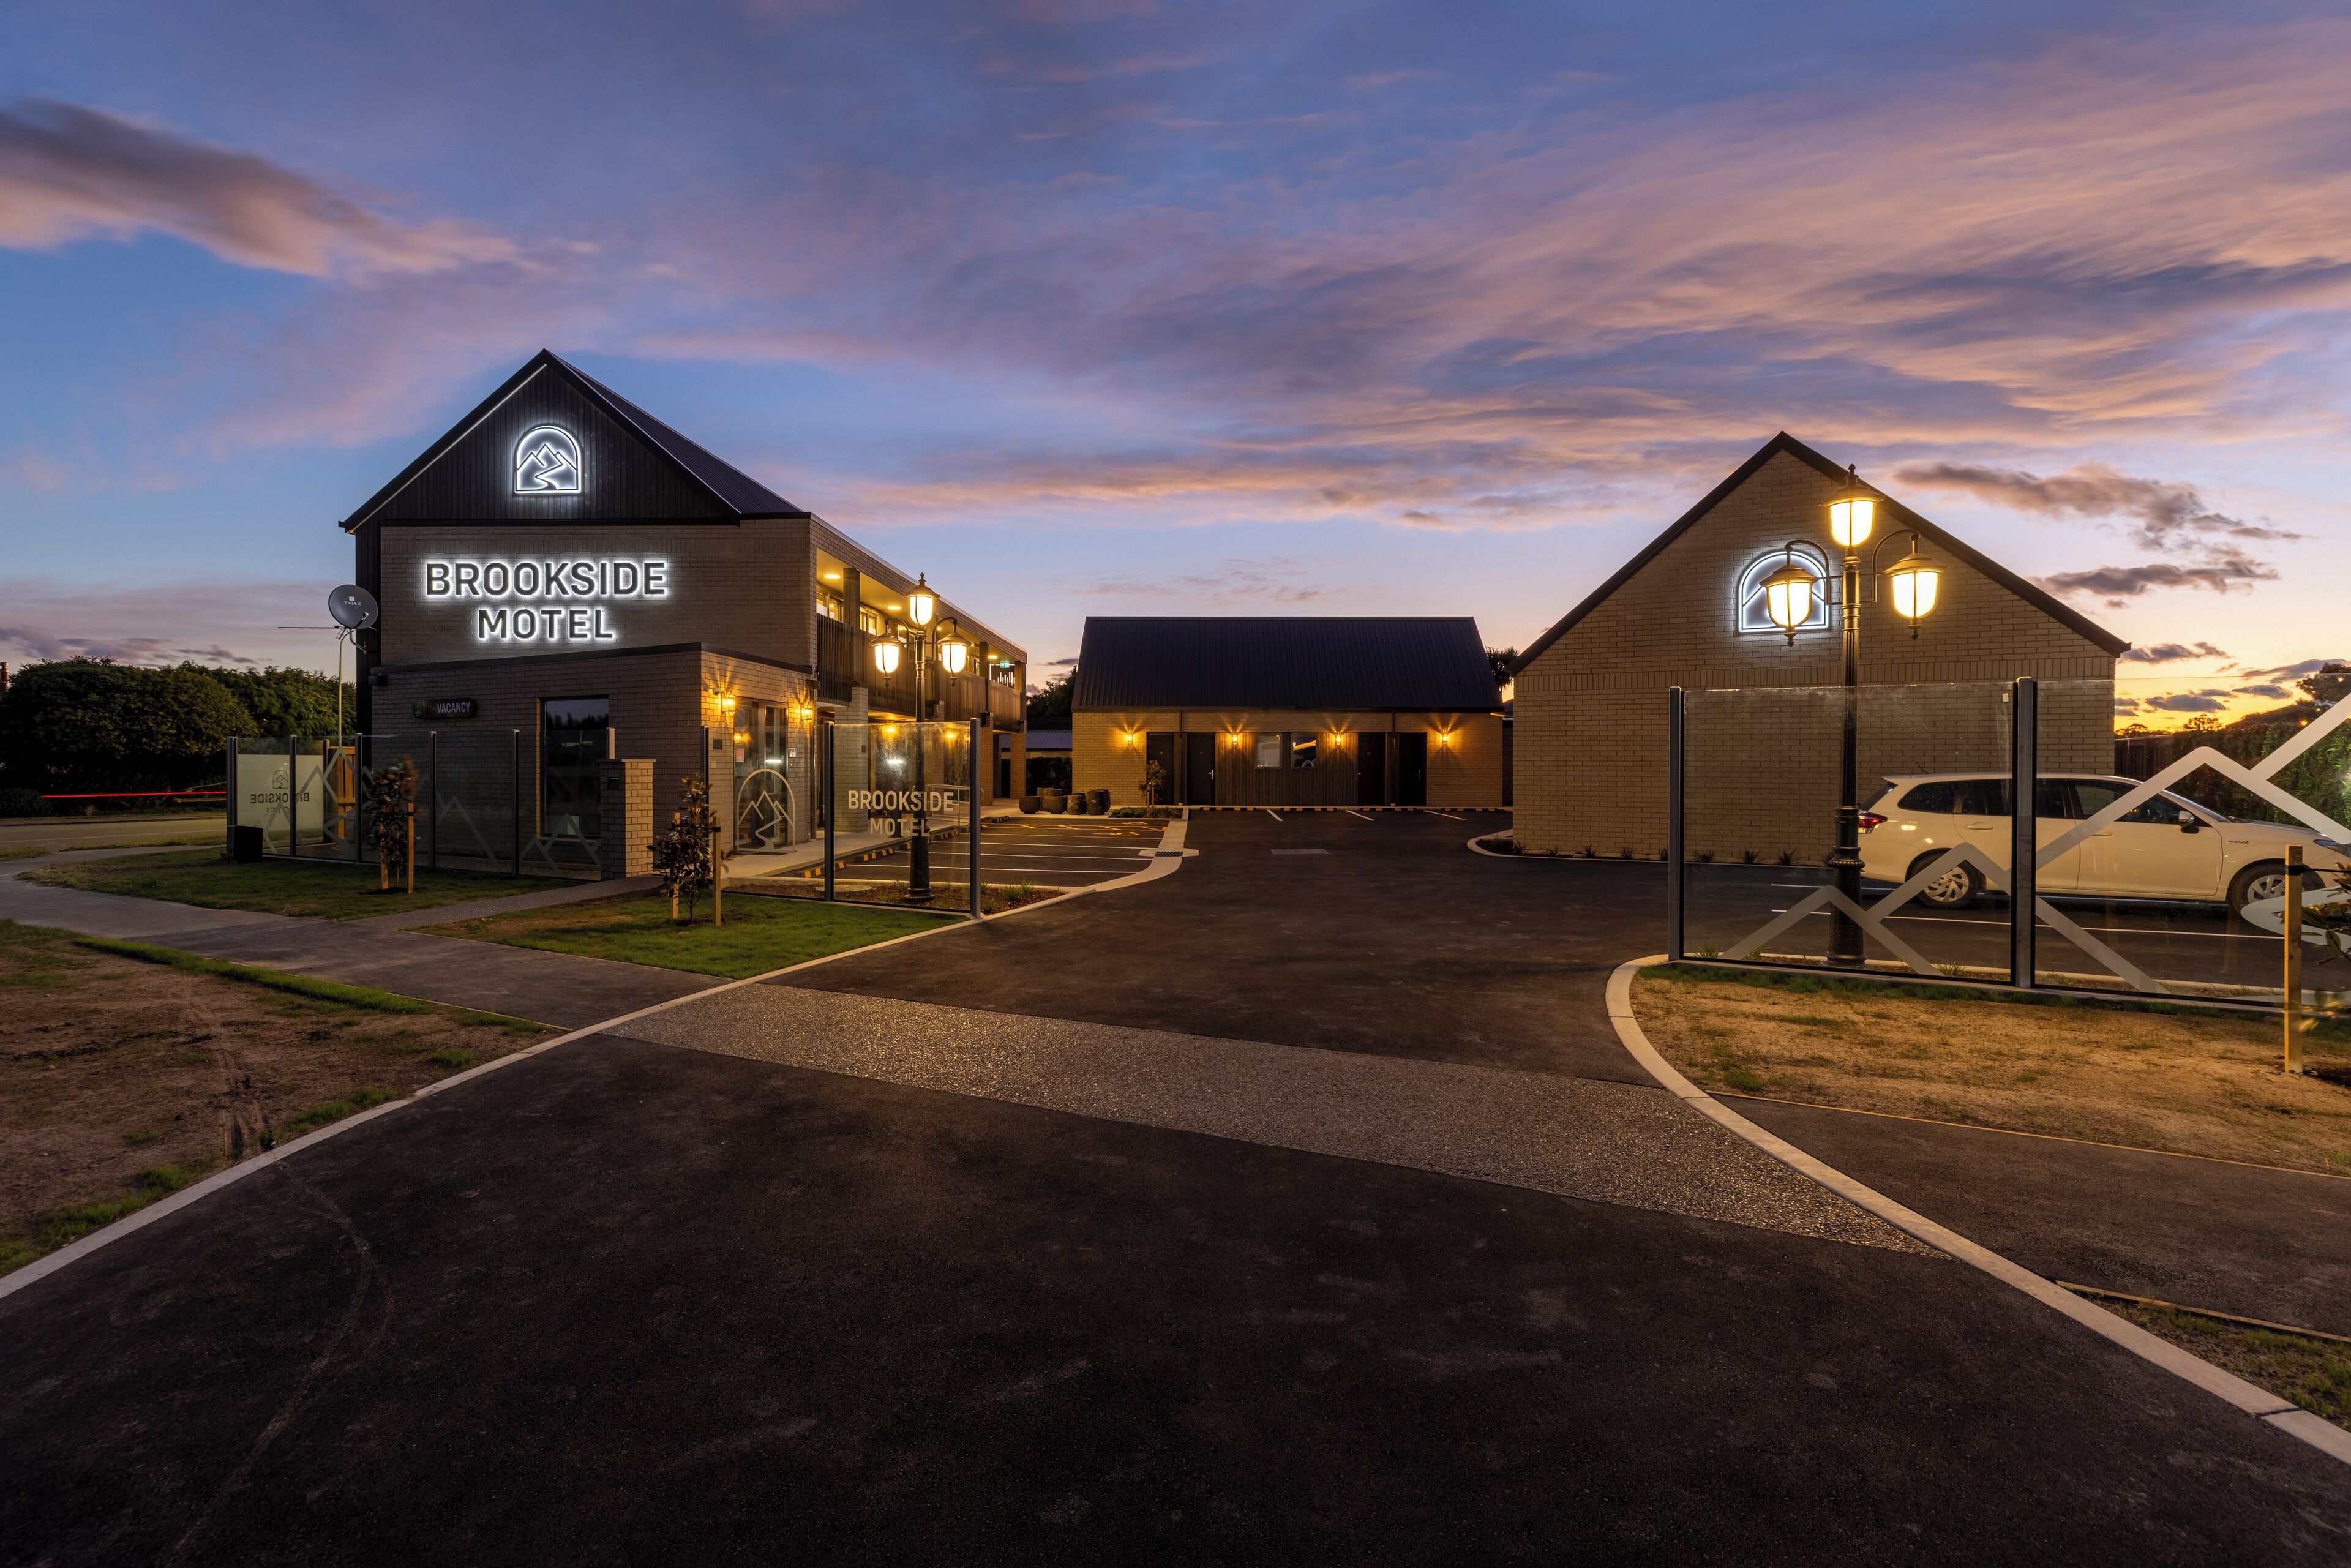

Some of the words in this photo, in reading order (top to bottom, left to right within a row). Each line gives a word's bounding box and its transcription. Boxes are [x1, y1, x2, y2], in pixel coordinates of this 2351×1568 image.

[426, 562, 666, 596] BROOKSIDE
[478, 609, 613, 639] MOTEL
[437, 702, 471, 714] VACANCY
[848, 790, 954, 812] BROOKSIDE
[869, 817, 930, 837] MOTEL
